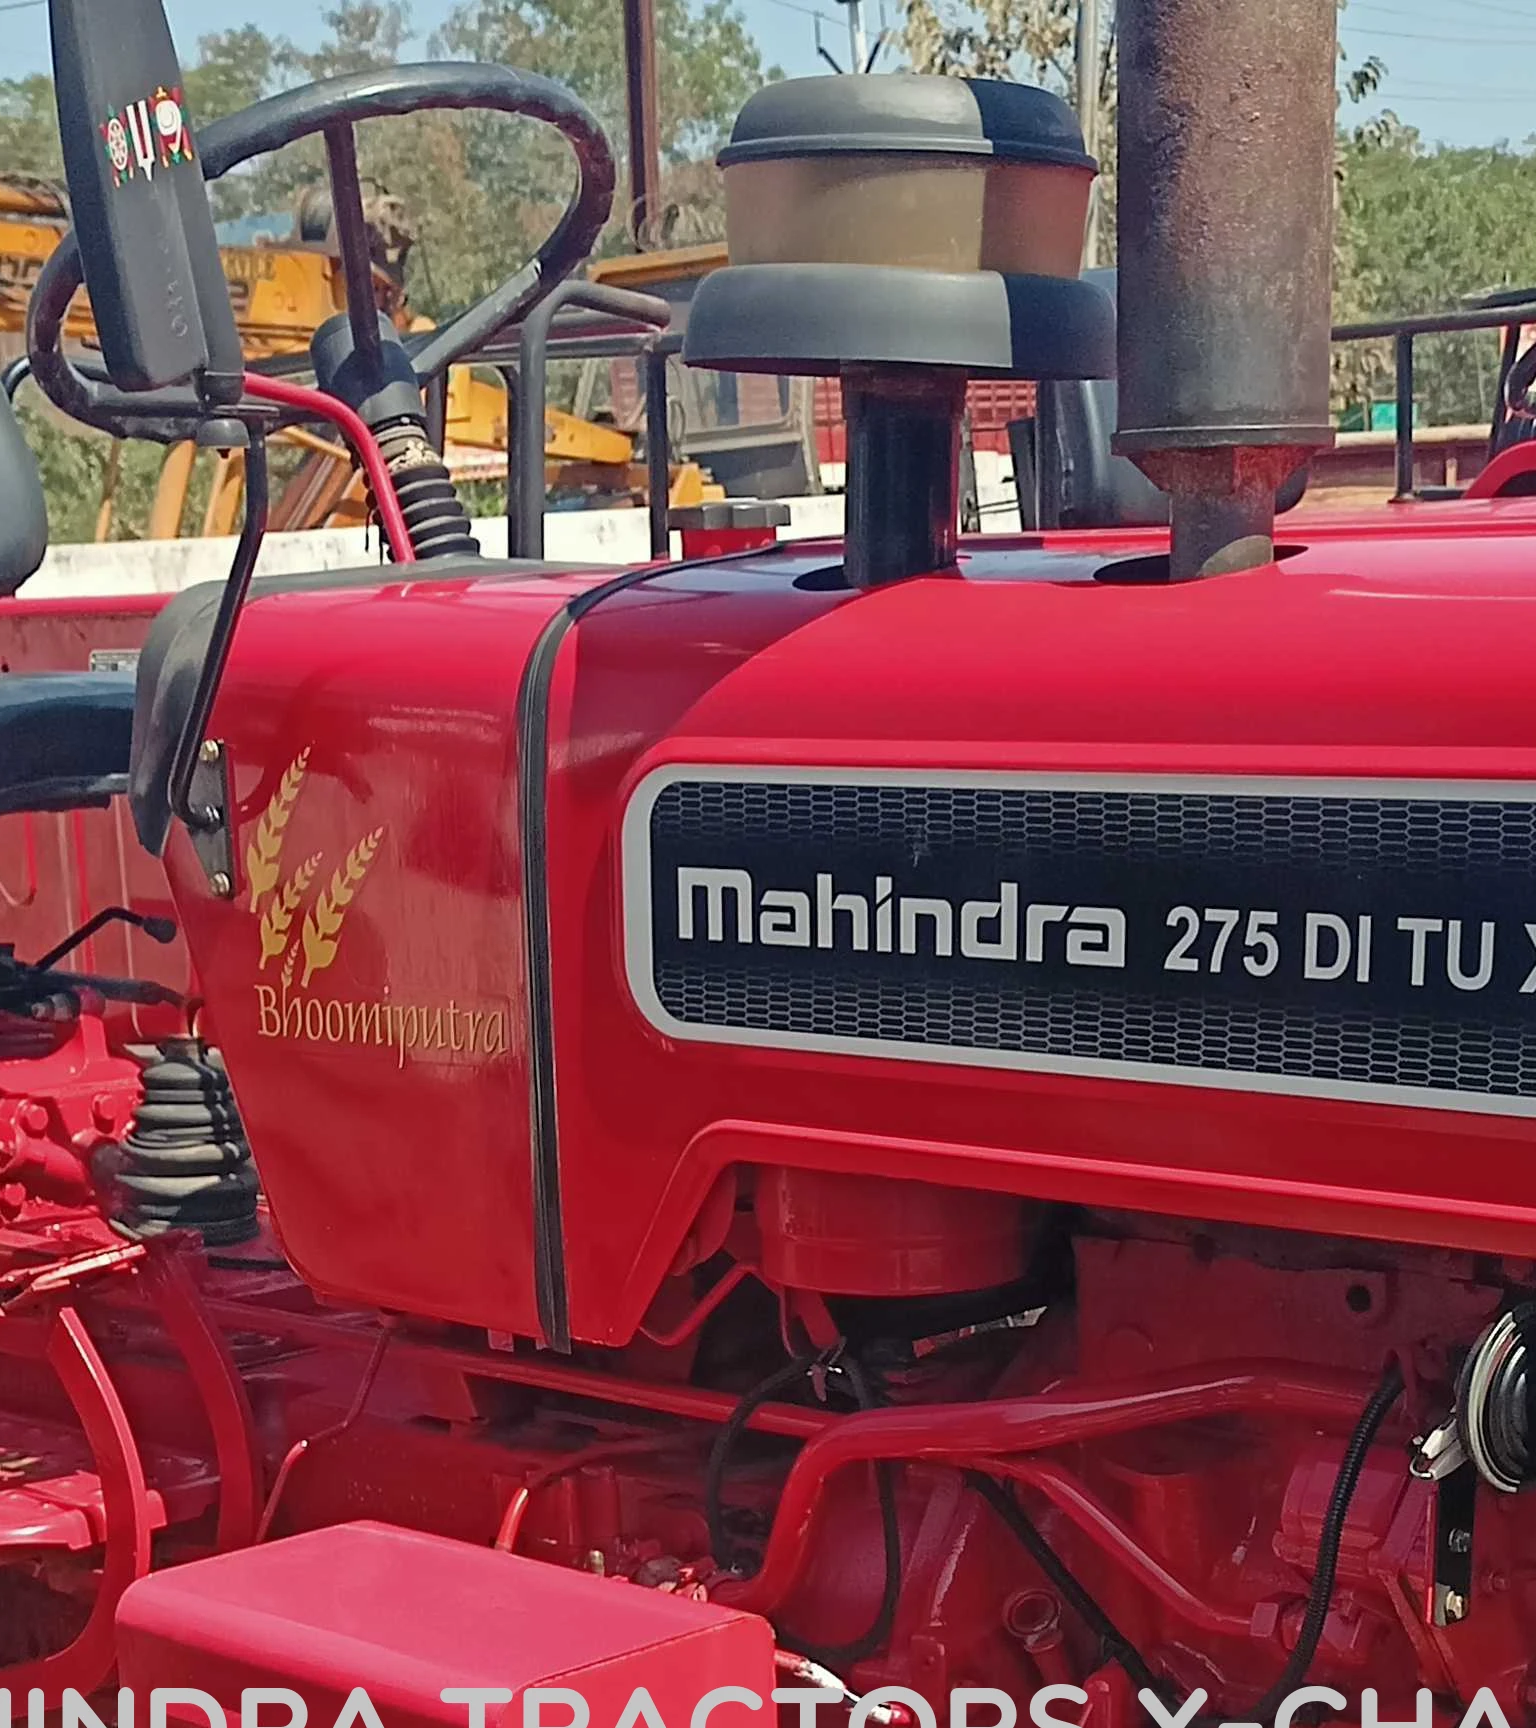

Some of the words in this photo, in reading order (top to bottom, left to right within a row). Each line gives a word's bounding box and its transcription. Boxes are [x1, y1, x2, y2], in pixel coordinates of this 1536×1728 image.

[676, 865, 1127, 969] Mahindra
[1164, 905, 1280, 978] 275
[1303, 911, 1373, 984] DI
[1396, 916, 1496, 991] TU
[254, 970, 508, 1069] Bhoomiputra
